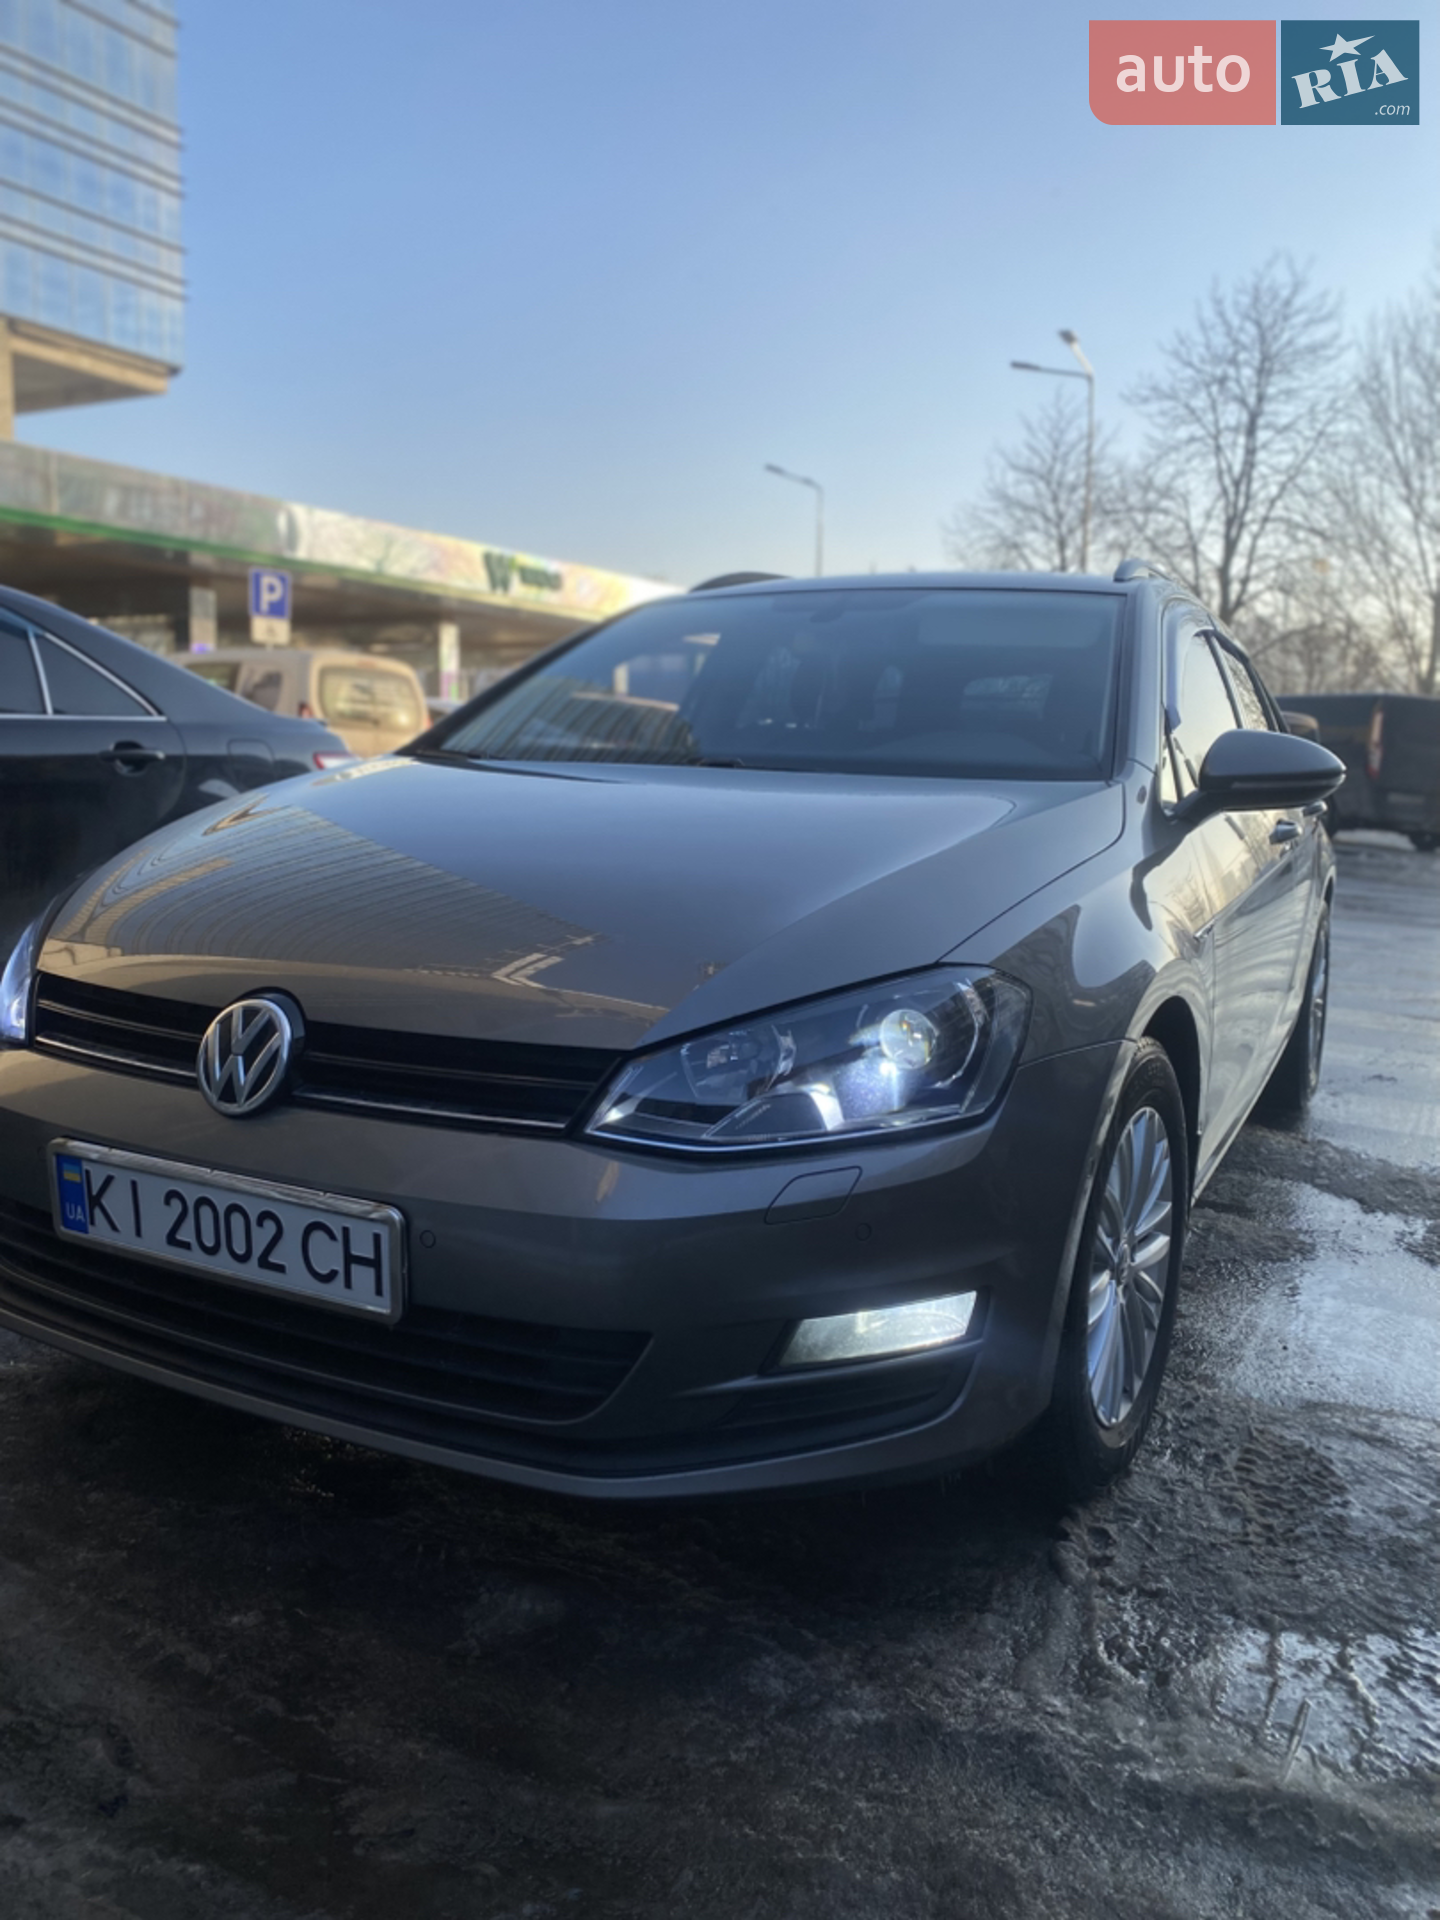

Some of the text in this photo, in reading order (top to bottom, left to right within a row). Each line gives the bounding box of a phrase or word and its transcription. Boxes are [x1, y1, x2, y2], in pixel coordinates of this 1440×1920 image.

[260, 575, 284, 613] P
[65, 1201, 86, 1223] UA
[163, 1188, 287, 1275] 2002
[301, 1220, 384, 1298] CH
